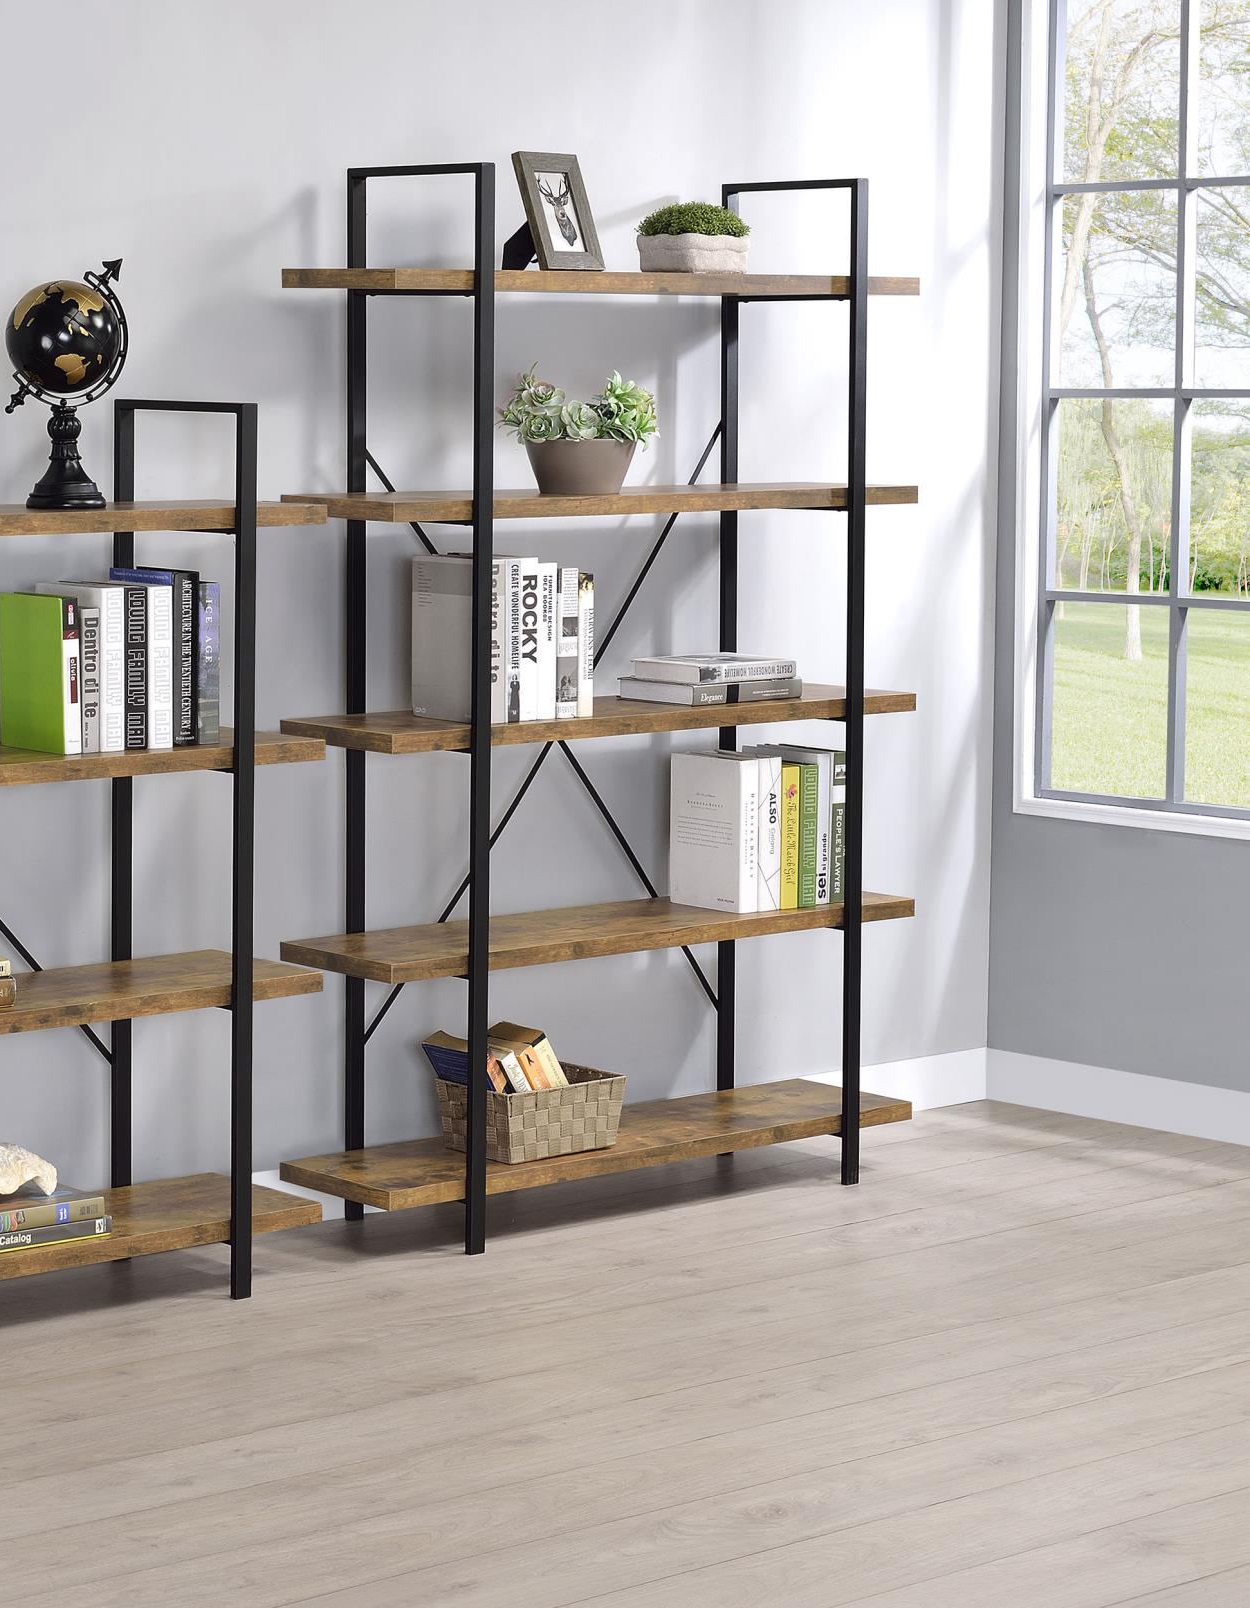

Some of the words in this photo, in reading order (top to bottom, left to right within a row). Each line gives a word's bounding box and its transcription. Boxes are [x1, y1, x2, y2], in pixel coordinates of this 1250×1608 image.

[511, 564, 520, 589] CREATE
[128, 590, 146, 644] LOVING
[205, 599, 213, 623] ICE
[511, 590, 520, 634] WONDERFUL
[522, 574, 538, 664] ROCKY
[84, 617, 99, 673] Dentro
[181, 633, 192, 641] IN
[181, 641, 192, 655] THE
[205, 635, 213, 663] AGE
[511, 635, 520, 670] HOMELIFE
[84, 678, 99, 694] di
[106, 649, 123, 707] FAMILY
[128, 648, 146, 707] FAMILY
[154, 646, 171, 704] FAMILY
[181, 656, 192, 697] TWENTIETH
[777, 664, 793, 675] CREATE
[84, 700, 99, 719] te
[181, 697, 192, 730] CENTURY
[106, 712, 123, 748] MAN
[128, 712, 146, 748] MAN
[154, 709, 170, 745] MAN
[786, 801, 797, 817] The
[803, 820, 816, 867] FAMILY
[835, 808, 844, 853] PEOPLE'S
[786, 840, 796, 867] Match
[784, 867, 796, 885] Girl
[802, 873, 815, 905] MAN
[816, 872, 827, 899] sei
[834, 854, 842, 894] LAWYER
[0, 1233, 32, 1246] Catalog
